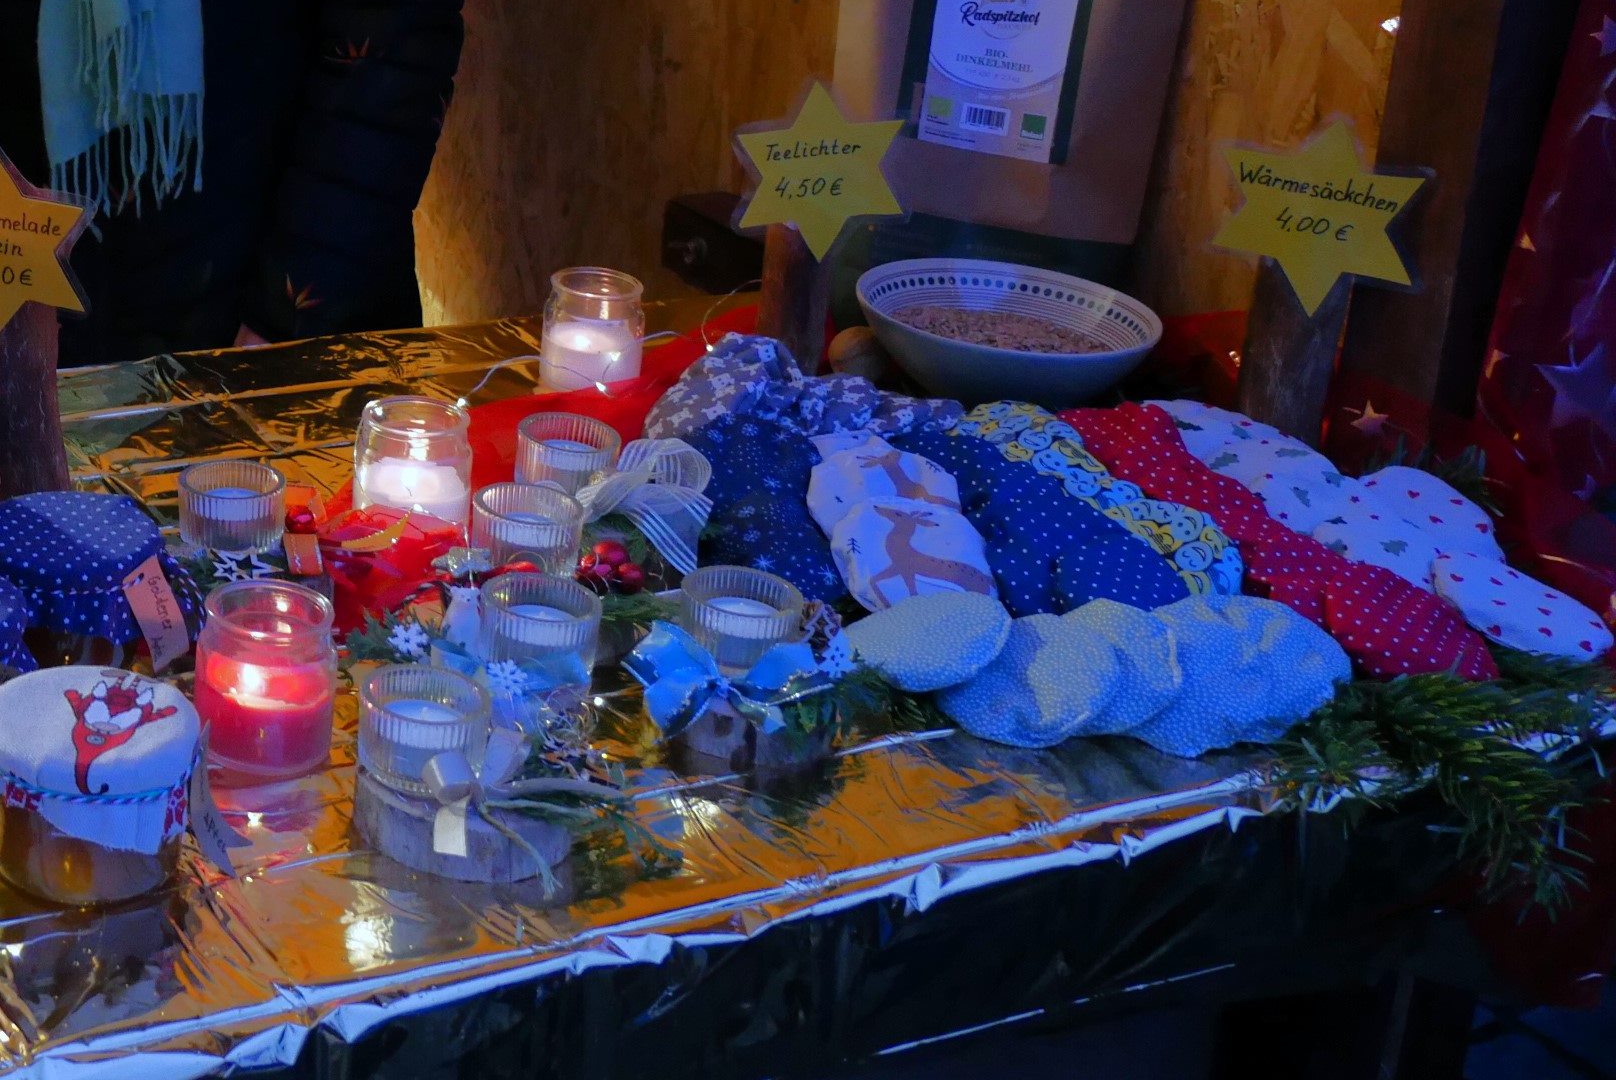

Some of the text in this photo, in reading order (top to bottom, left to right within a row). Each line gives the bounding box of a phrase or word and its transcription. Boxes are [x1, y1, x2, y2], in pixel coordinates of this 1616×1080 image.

[960, 1, 1040, 27] Radspitzhof
[766, 138, 862, 161] Teelichter
[1239, 161, 1398, 213] Wärmesäckchen
